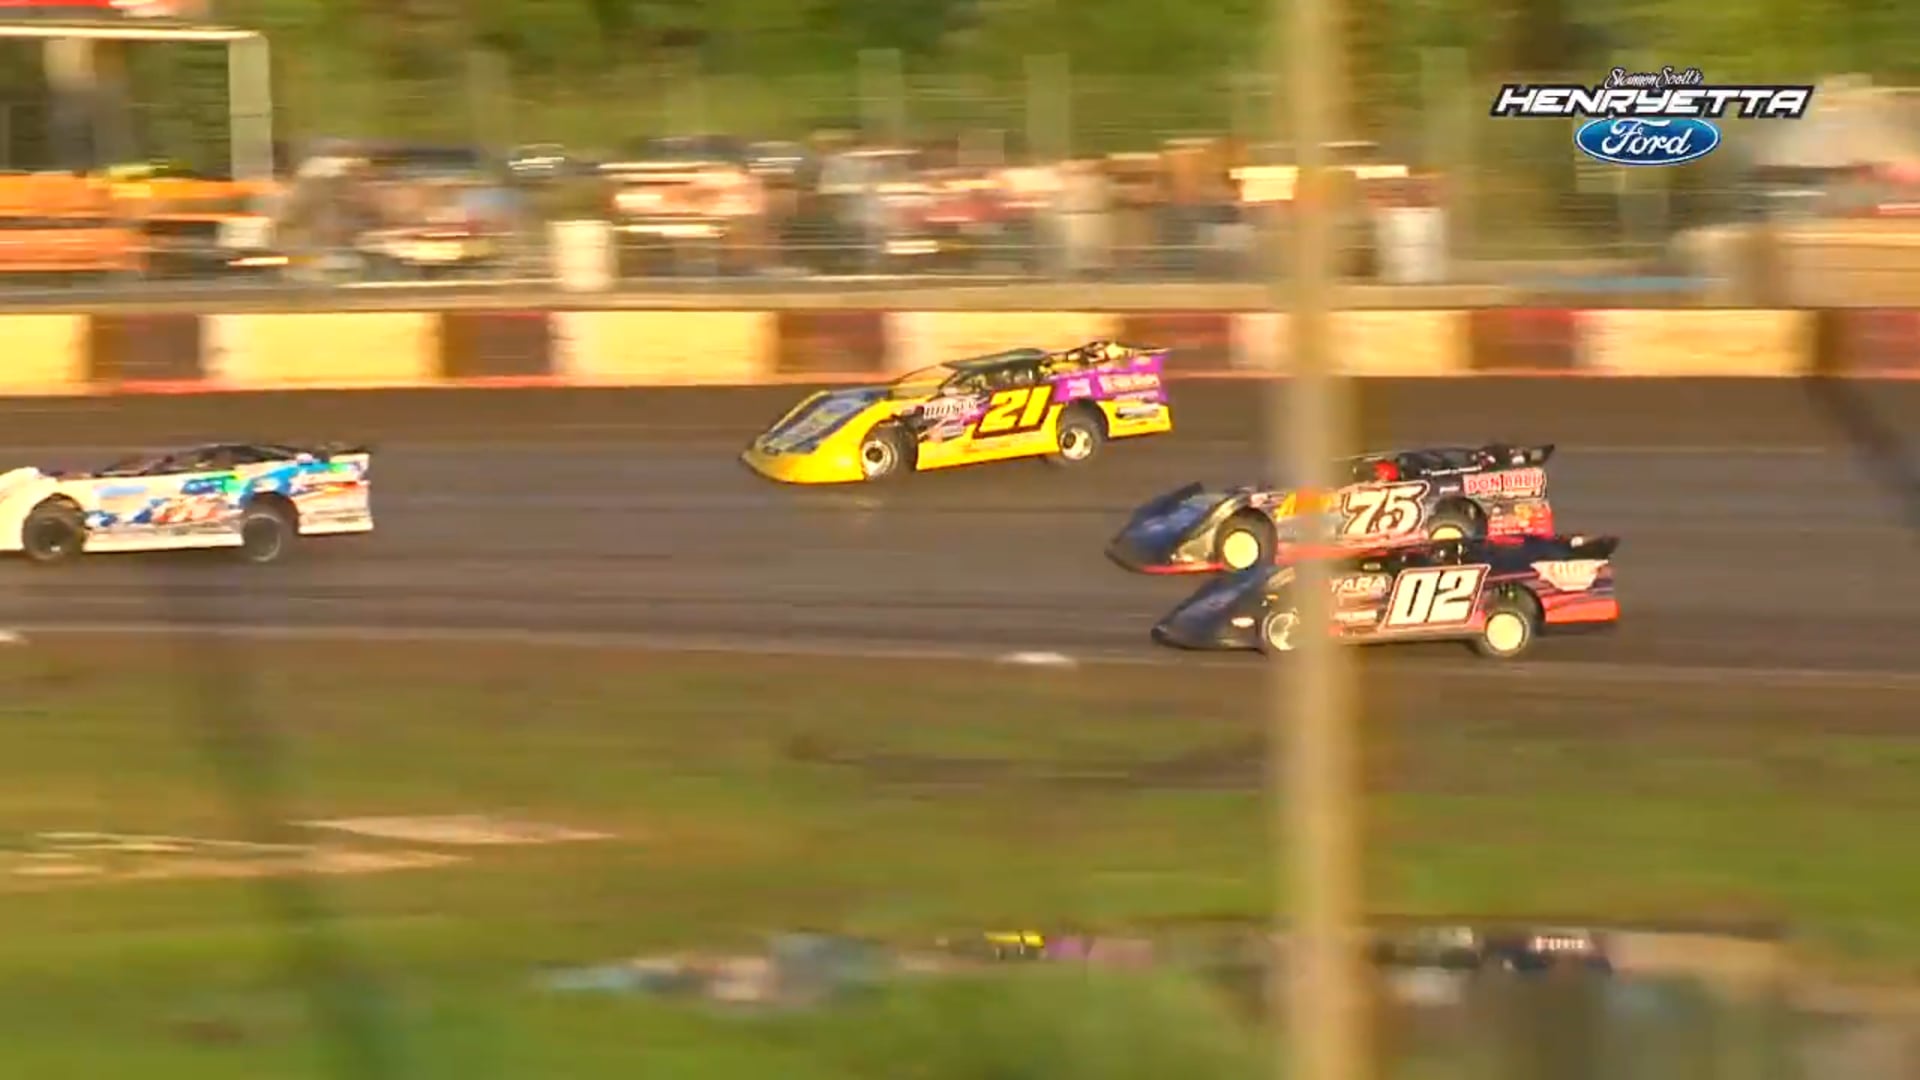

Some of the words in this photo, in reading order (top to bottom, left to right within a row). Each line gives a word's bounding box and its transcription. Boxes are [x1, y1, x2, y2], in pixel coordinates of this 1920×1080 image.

[977, 384, 1054, 434] 21
[1345, 481, 1426, 536] 75
[1387, 568, 1486, 625] 02
